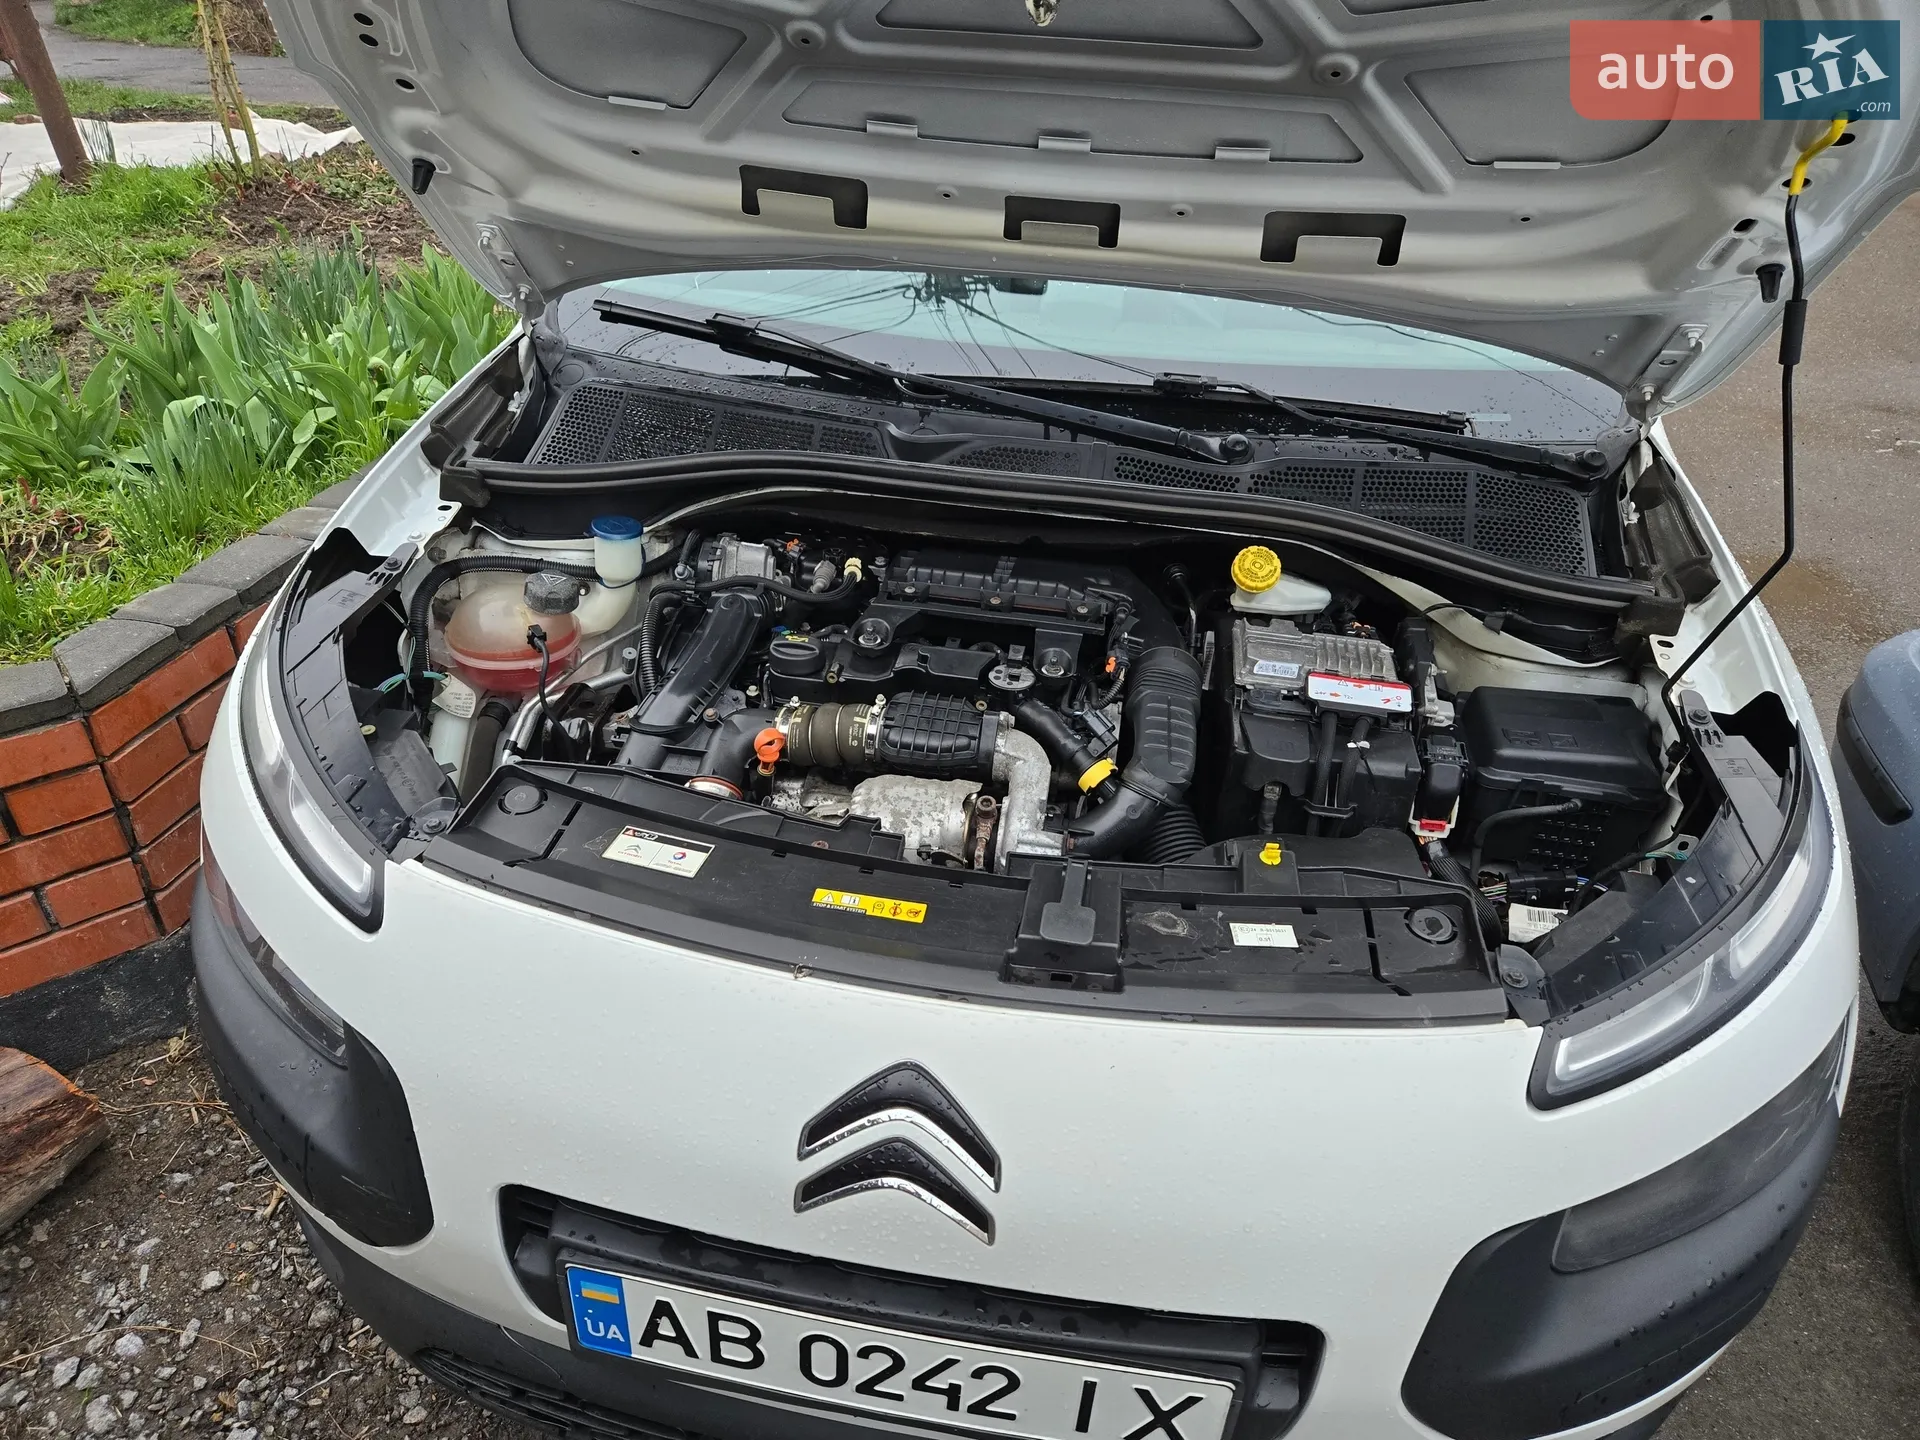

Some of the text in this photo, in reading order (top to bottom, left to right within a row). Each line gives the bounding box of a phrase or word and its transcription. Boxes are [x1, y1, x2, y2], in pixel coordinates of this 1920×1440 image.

[585, 1319, 626, 1343] UA
[639, 1298, 1205, 1440] AB 0242 IX
